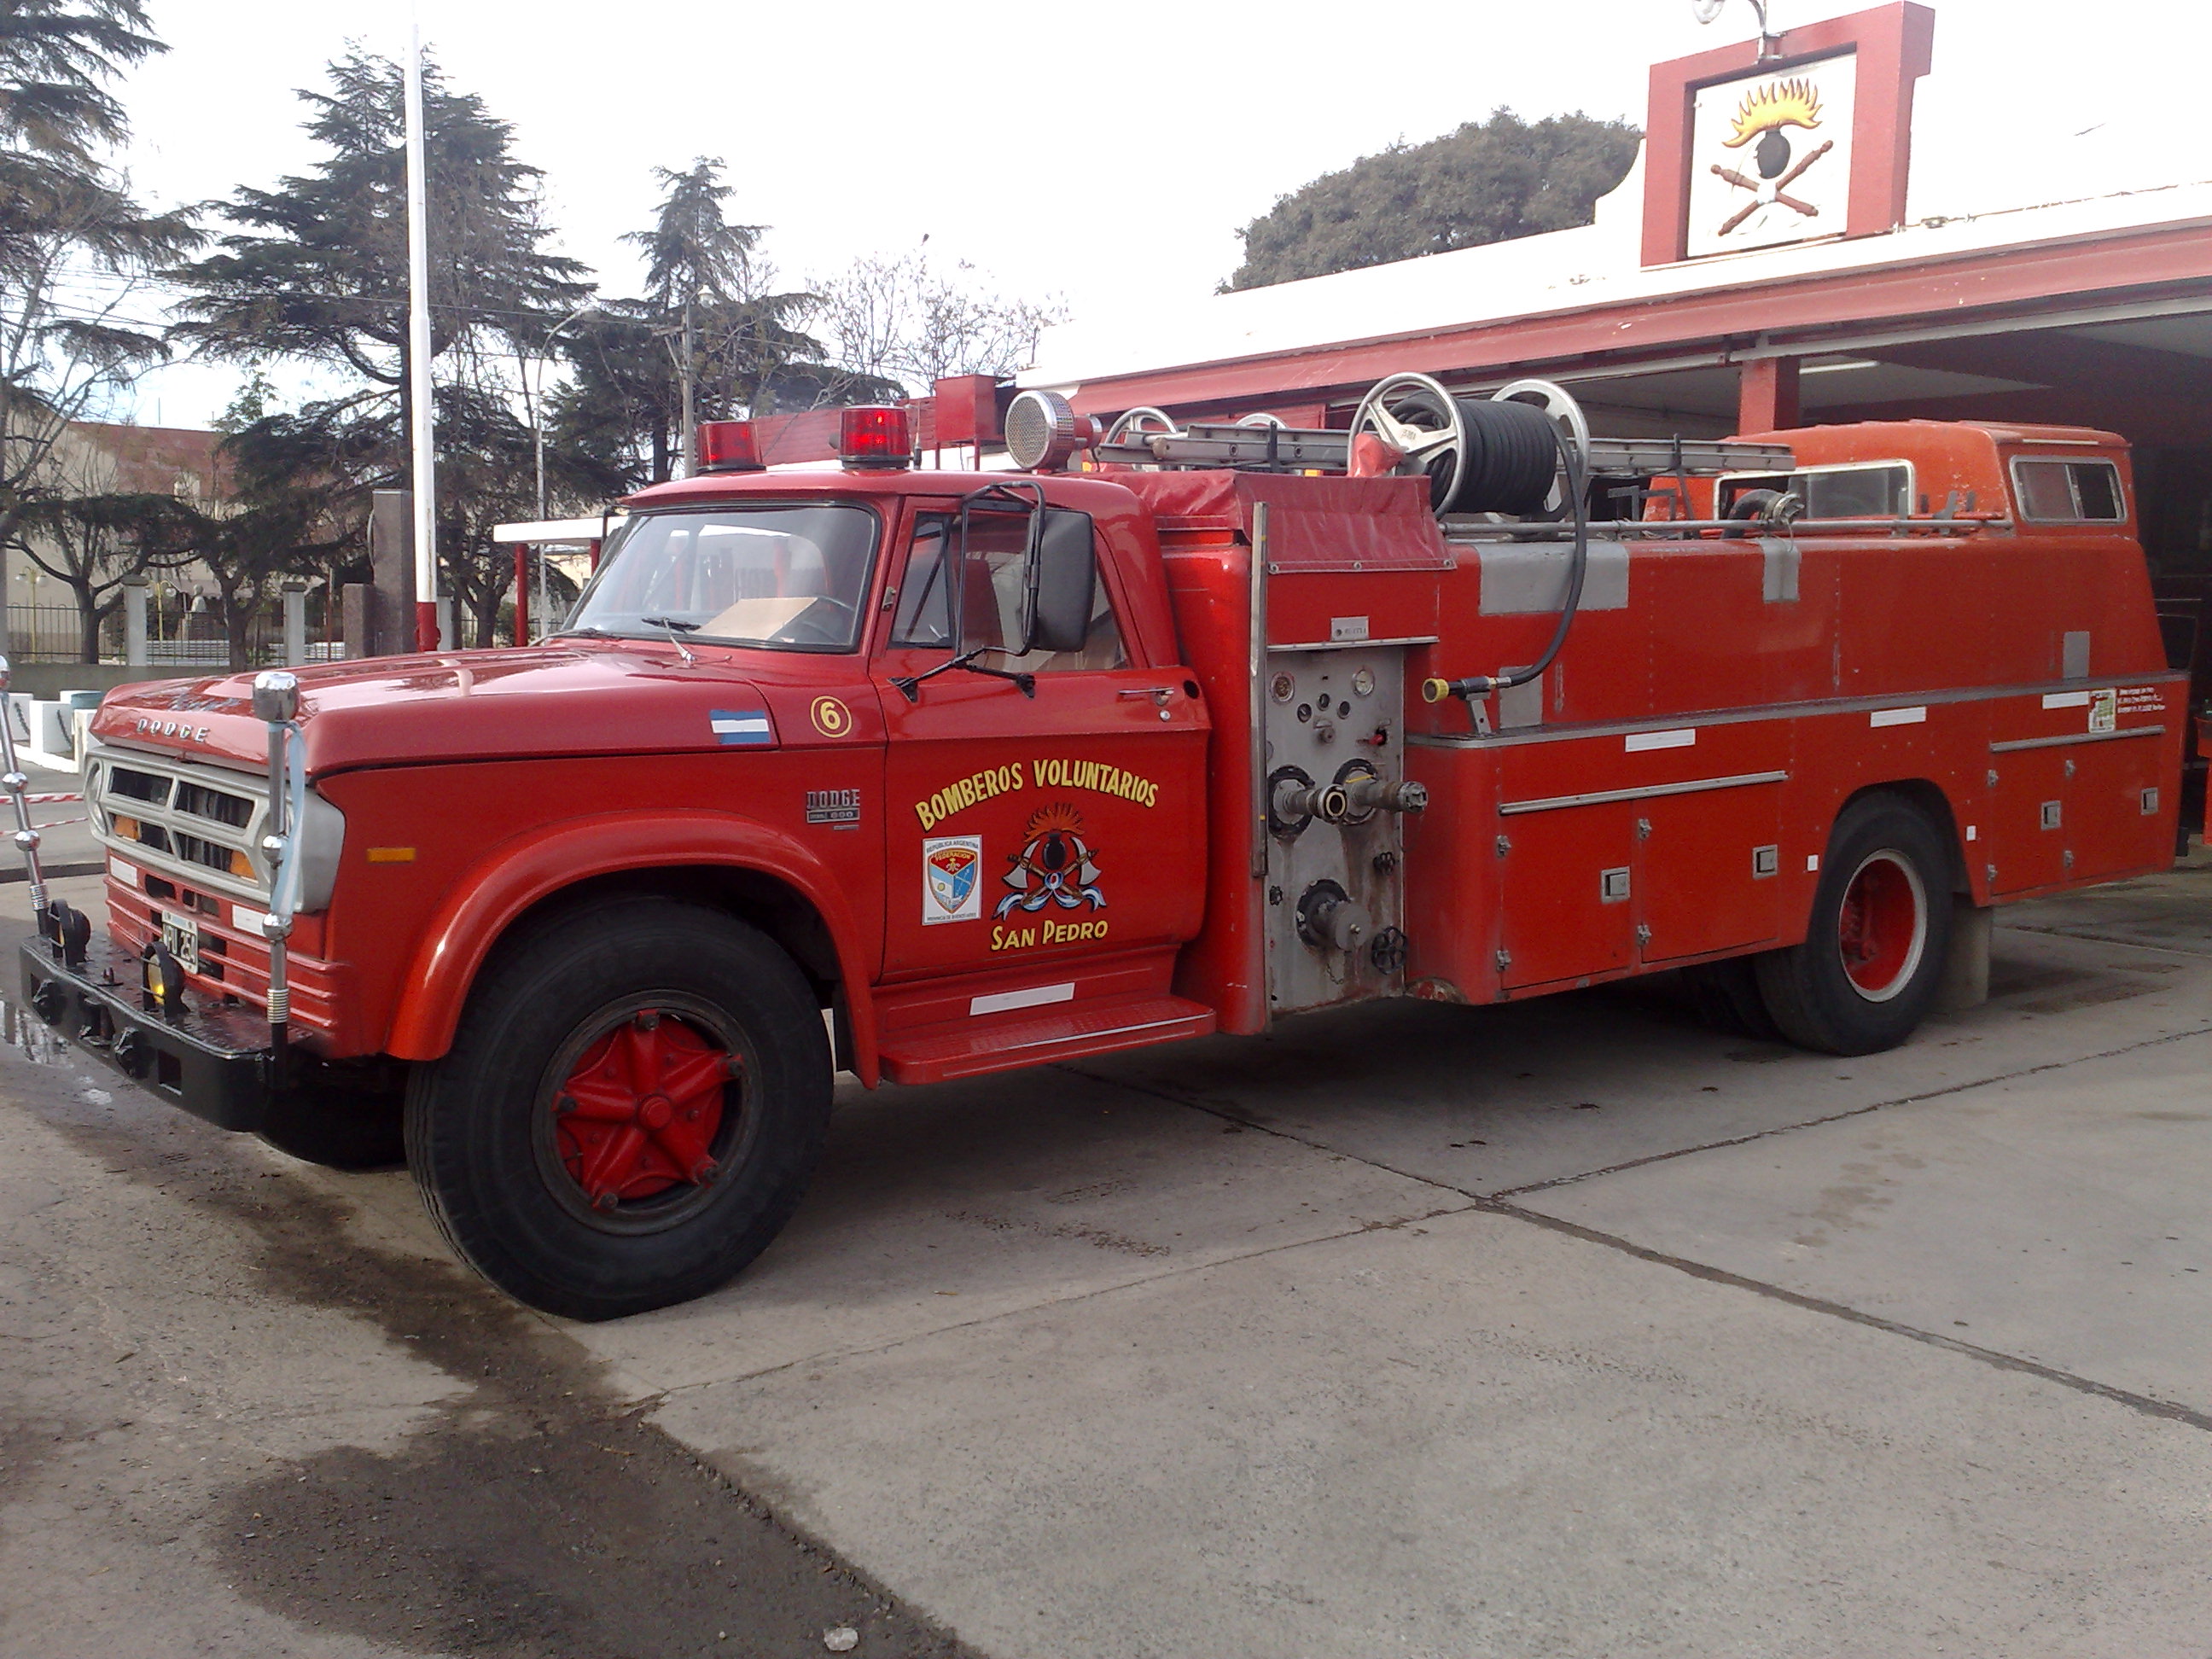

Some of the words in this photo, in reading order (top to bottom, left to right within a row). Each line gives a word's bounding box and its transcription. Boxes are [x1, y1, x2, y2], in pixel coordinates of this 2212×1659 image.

[820, 701, 841, 730] 6
[137, 718, 211, 742] DODGE
[806, 789, 860, 809] DODGE
[915, 762, 1023, 831] BOMBEROS
[1033, 759, 1159, 808] VOLUNTARIOS
